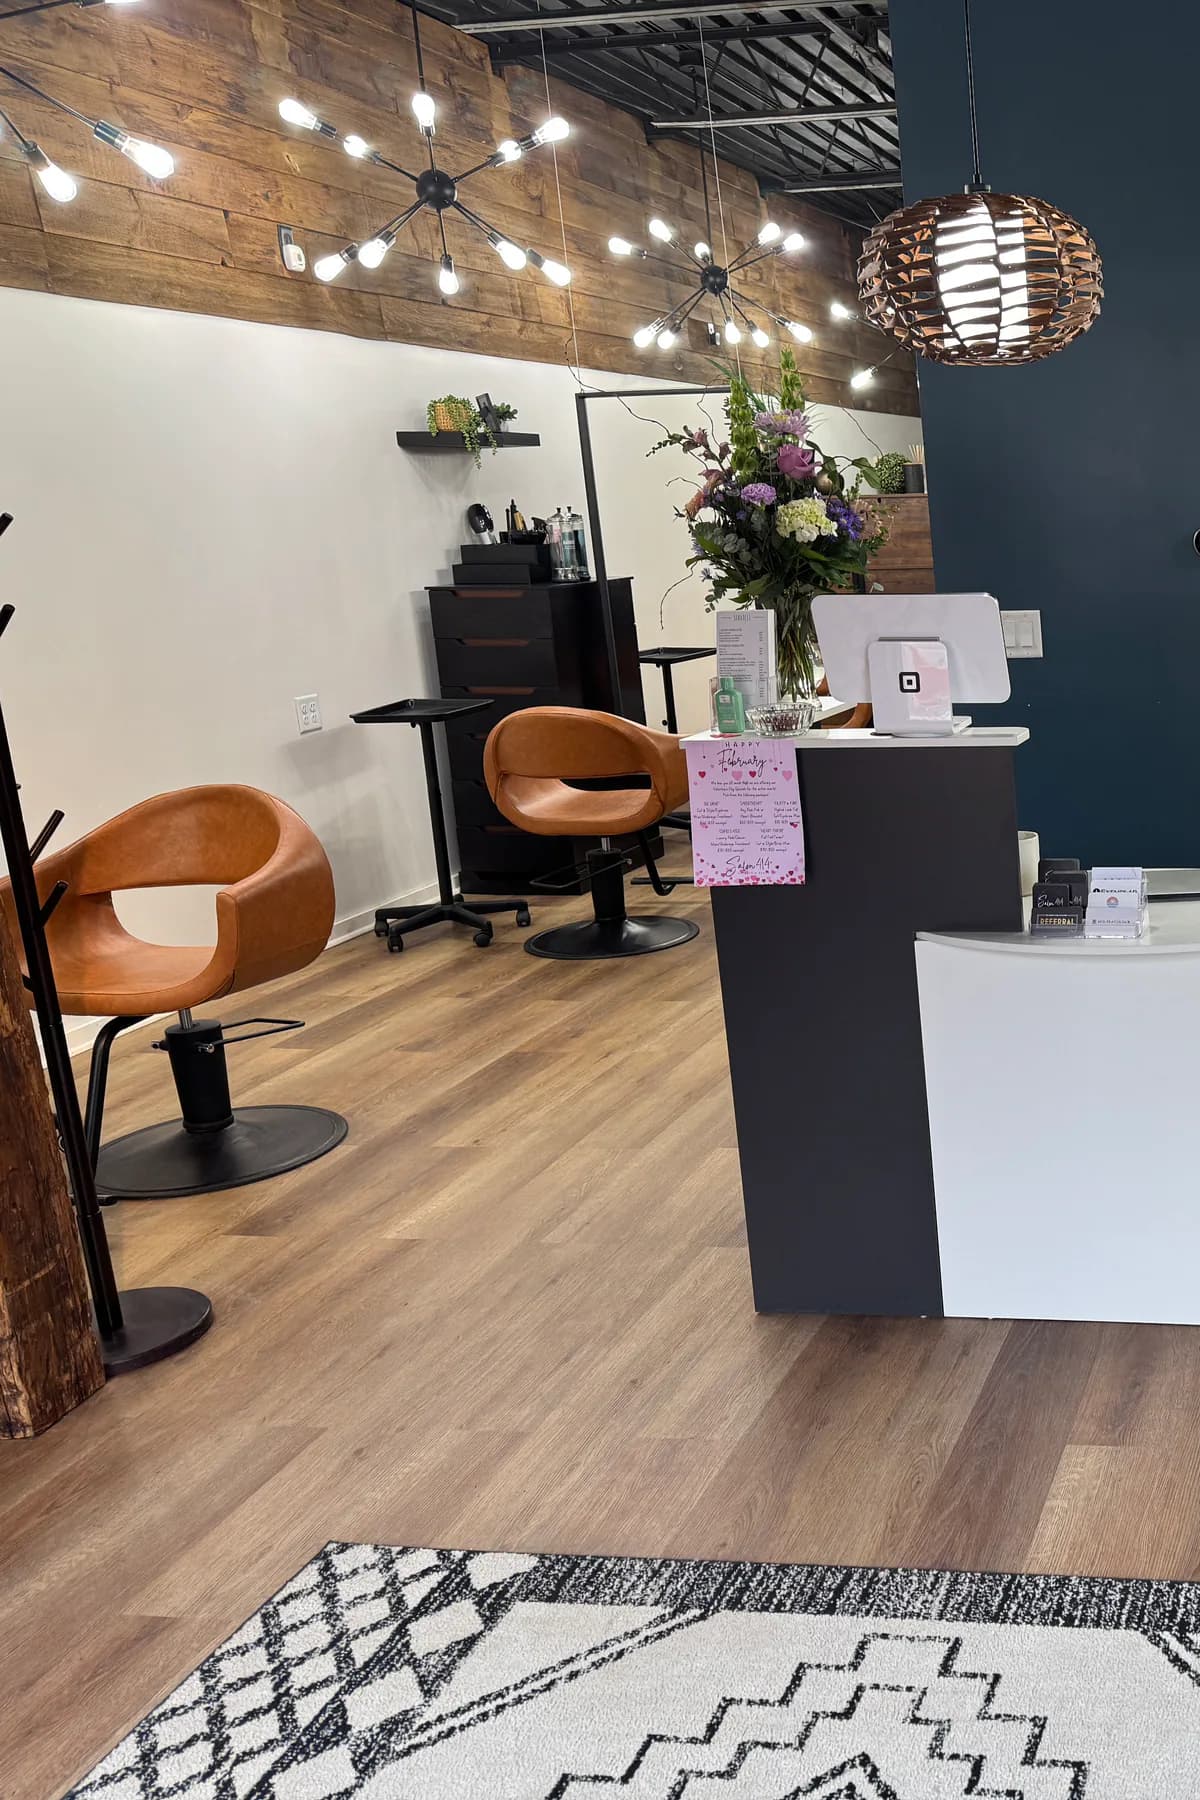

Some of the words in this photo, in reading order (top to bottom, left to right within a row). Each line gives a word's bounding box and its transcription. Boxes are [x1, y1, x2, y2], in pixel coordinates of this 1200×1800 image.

[717, 748, 767, 777] February
[725, 855, 756, 877] Salon
[1040, 917, 1074, 926] REFERRAL
